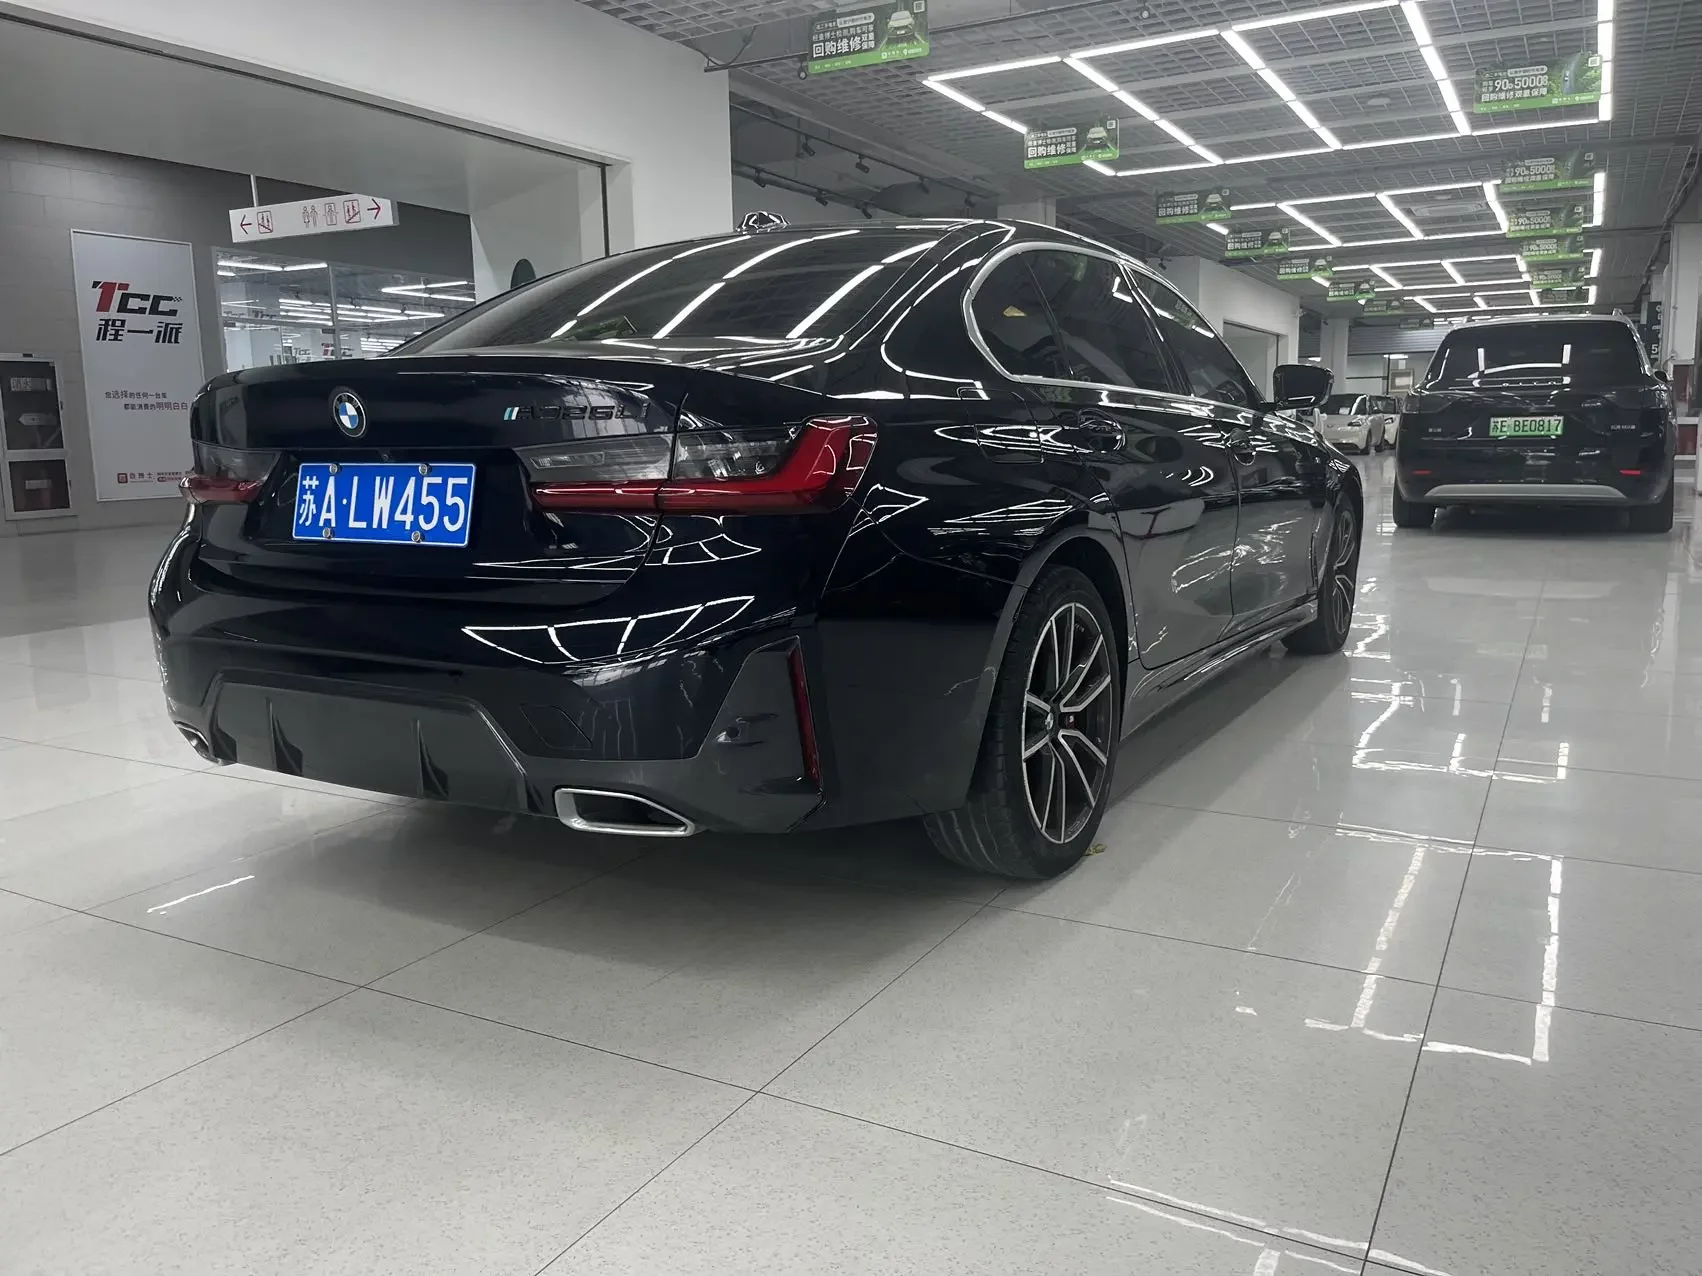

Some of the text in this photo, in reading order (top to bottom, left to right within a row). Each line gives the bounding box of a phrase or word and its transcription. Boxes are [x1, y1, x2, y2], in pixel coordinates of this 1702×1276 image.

[812, 37, 861, 58] 回购维修
[1027, 143, 1066, 158] 回购维修
[92, 281, 182, 317] TCC
[96, 318, 183, 344] 程一派
[1513, 418, 1562, 433] BE0817
[299, 475, 468, 532] 苏A·LW455
